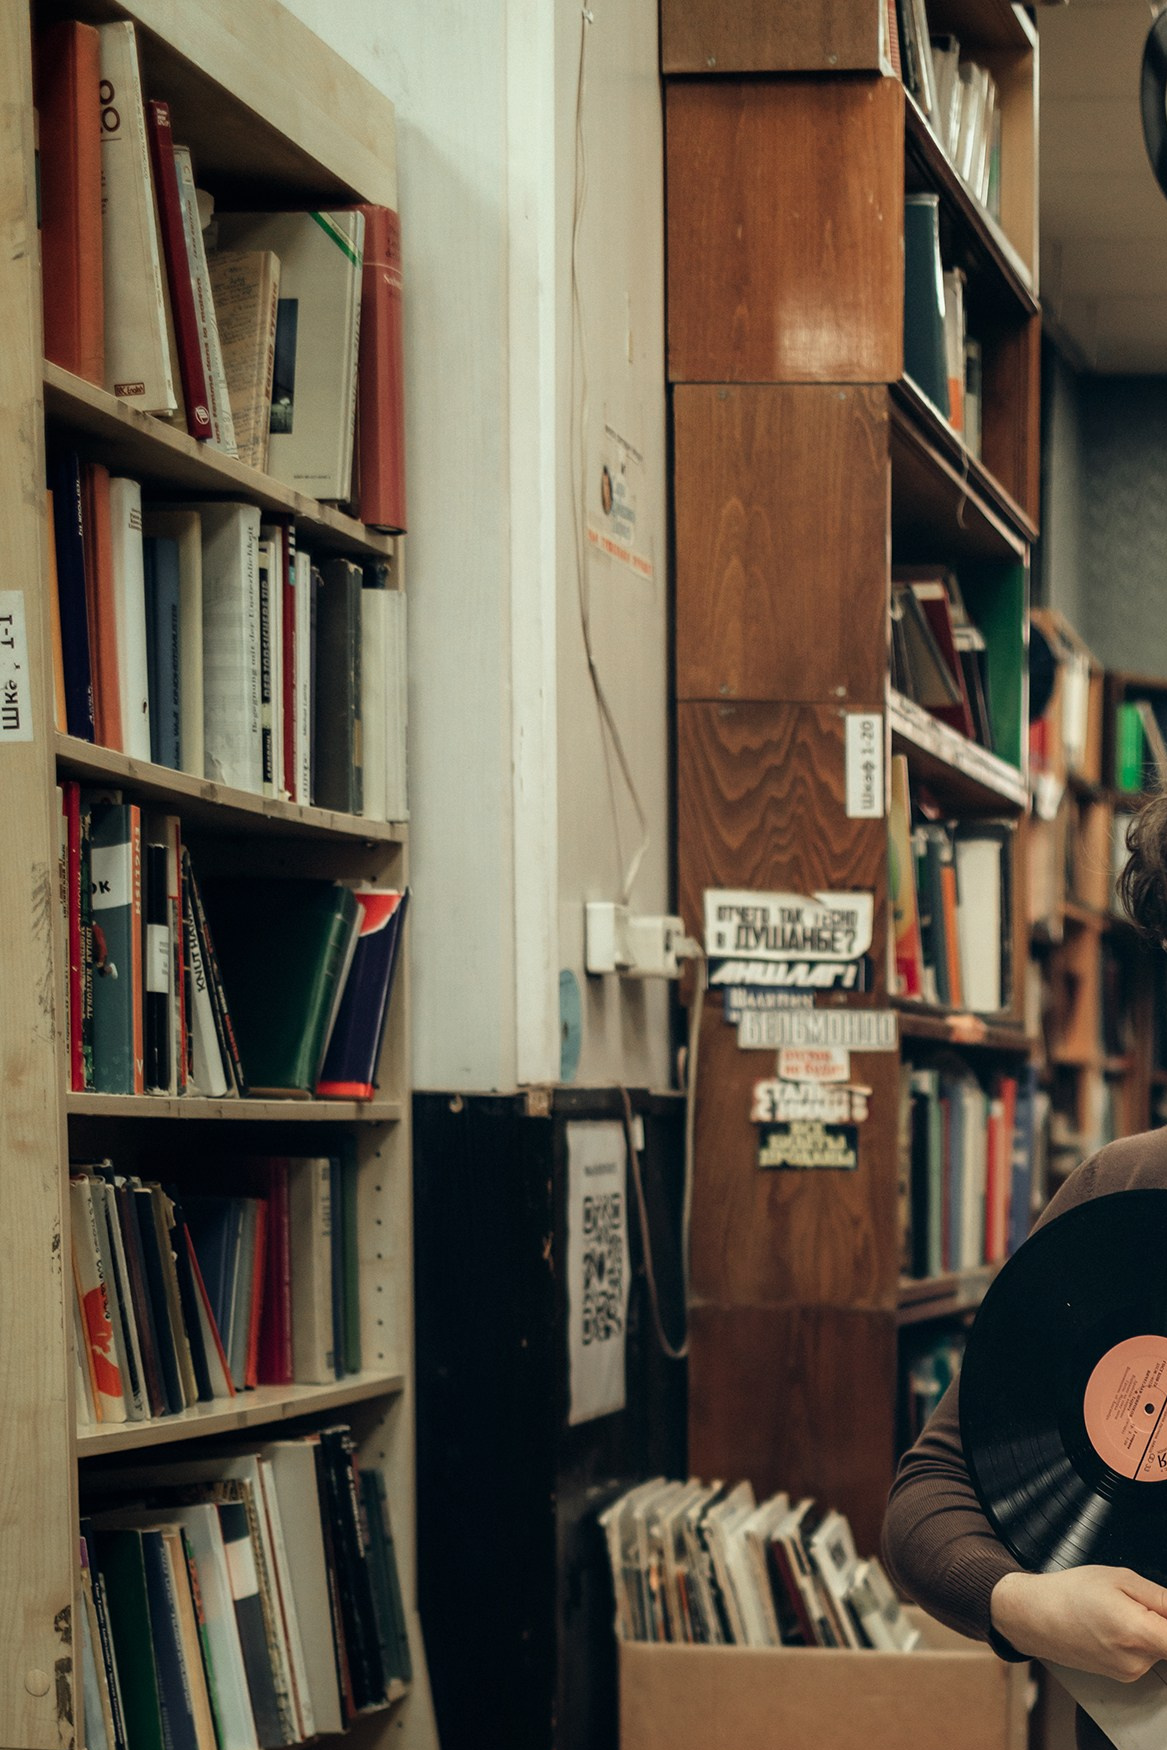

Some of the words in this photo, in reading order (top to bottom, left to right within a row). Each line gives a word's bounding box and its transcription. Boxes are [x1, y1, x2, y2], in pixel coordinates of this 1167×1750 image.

[192, 276, 209, 322] maison
[200, 328, 208, 338] la
[201, 341, 214, 371] dans
[204, 375, 220, 417] femme
[212, 421, 222, 443] une
[246, 525, 256, 617] Unsterblichkeit
[248, 622, 256, 642] der
[249, 668, 259, 733] Begegnung
[861, 720, 876, 756] 1-20
[861, 758, 877, 810] Шкаф
[779, 907, 804, 924] ТАК
[735, 924, 857, 953] ДУШАНБЕ?
[193, 950, 207, 993] KNUT
[709, 960, 859, 989] АНШЛАГ!
[740, 1010, 898, 1049] БЕЛЬМОНДО
[1128, 1394, 1140, 1417] ШИРОКОВ
[1143, 1463, 1150, 1472] 33
